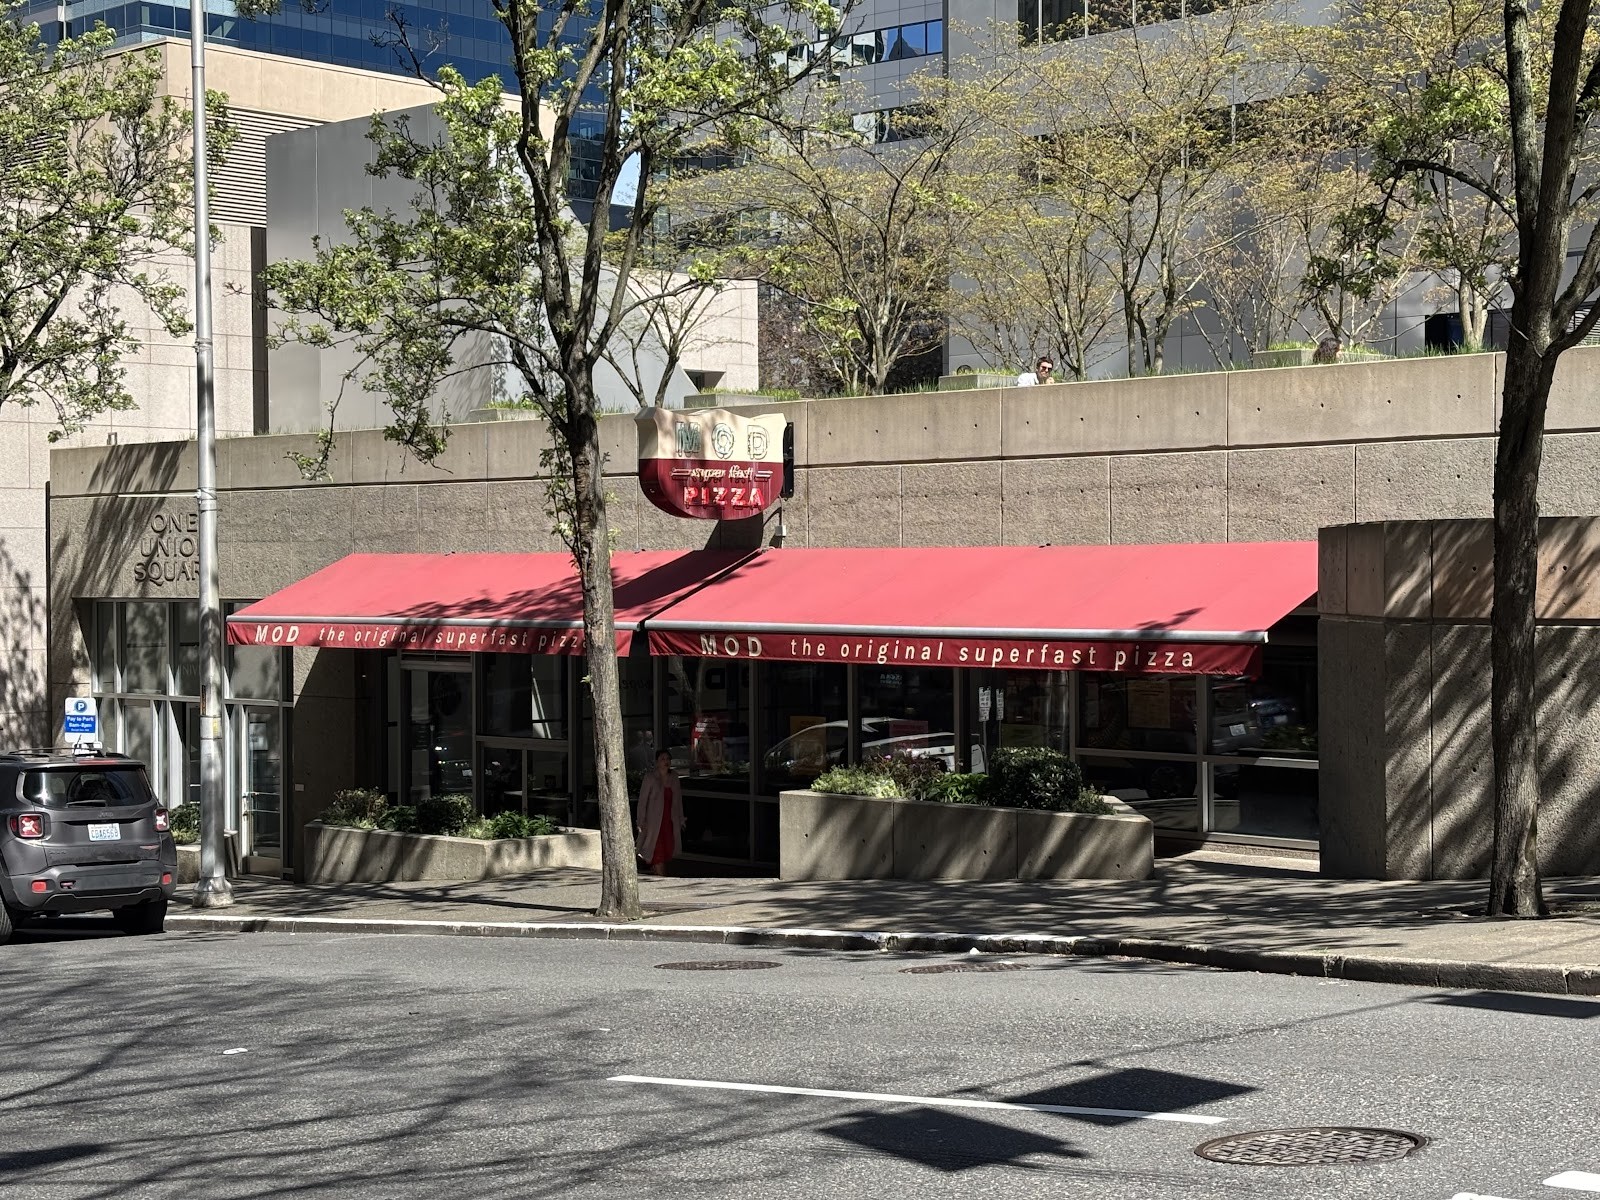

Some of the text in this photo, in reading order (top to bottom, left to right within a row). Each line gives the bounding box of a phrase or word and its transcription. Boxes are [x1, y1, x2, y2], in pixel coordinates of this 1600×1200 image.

[675, 420, 770, 459] MOD
[689, 464, 754, 482] super fast
[683, 486, 764, 509] PIZZA
[151, 513, 198, 533] ONE
[140, 536, 199, 558] UNIO
[134, 560, 199, 586] SQUAR
[254, 625, 301, 643] MOD
[318, 626, 346, 642] the
[354, 626, 427, 648] original
[434, 629, 529, 648] superfast
[700, 634, 1195, 671] MOD the original superfast pizza
